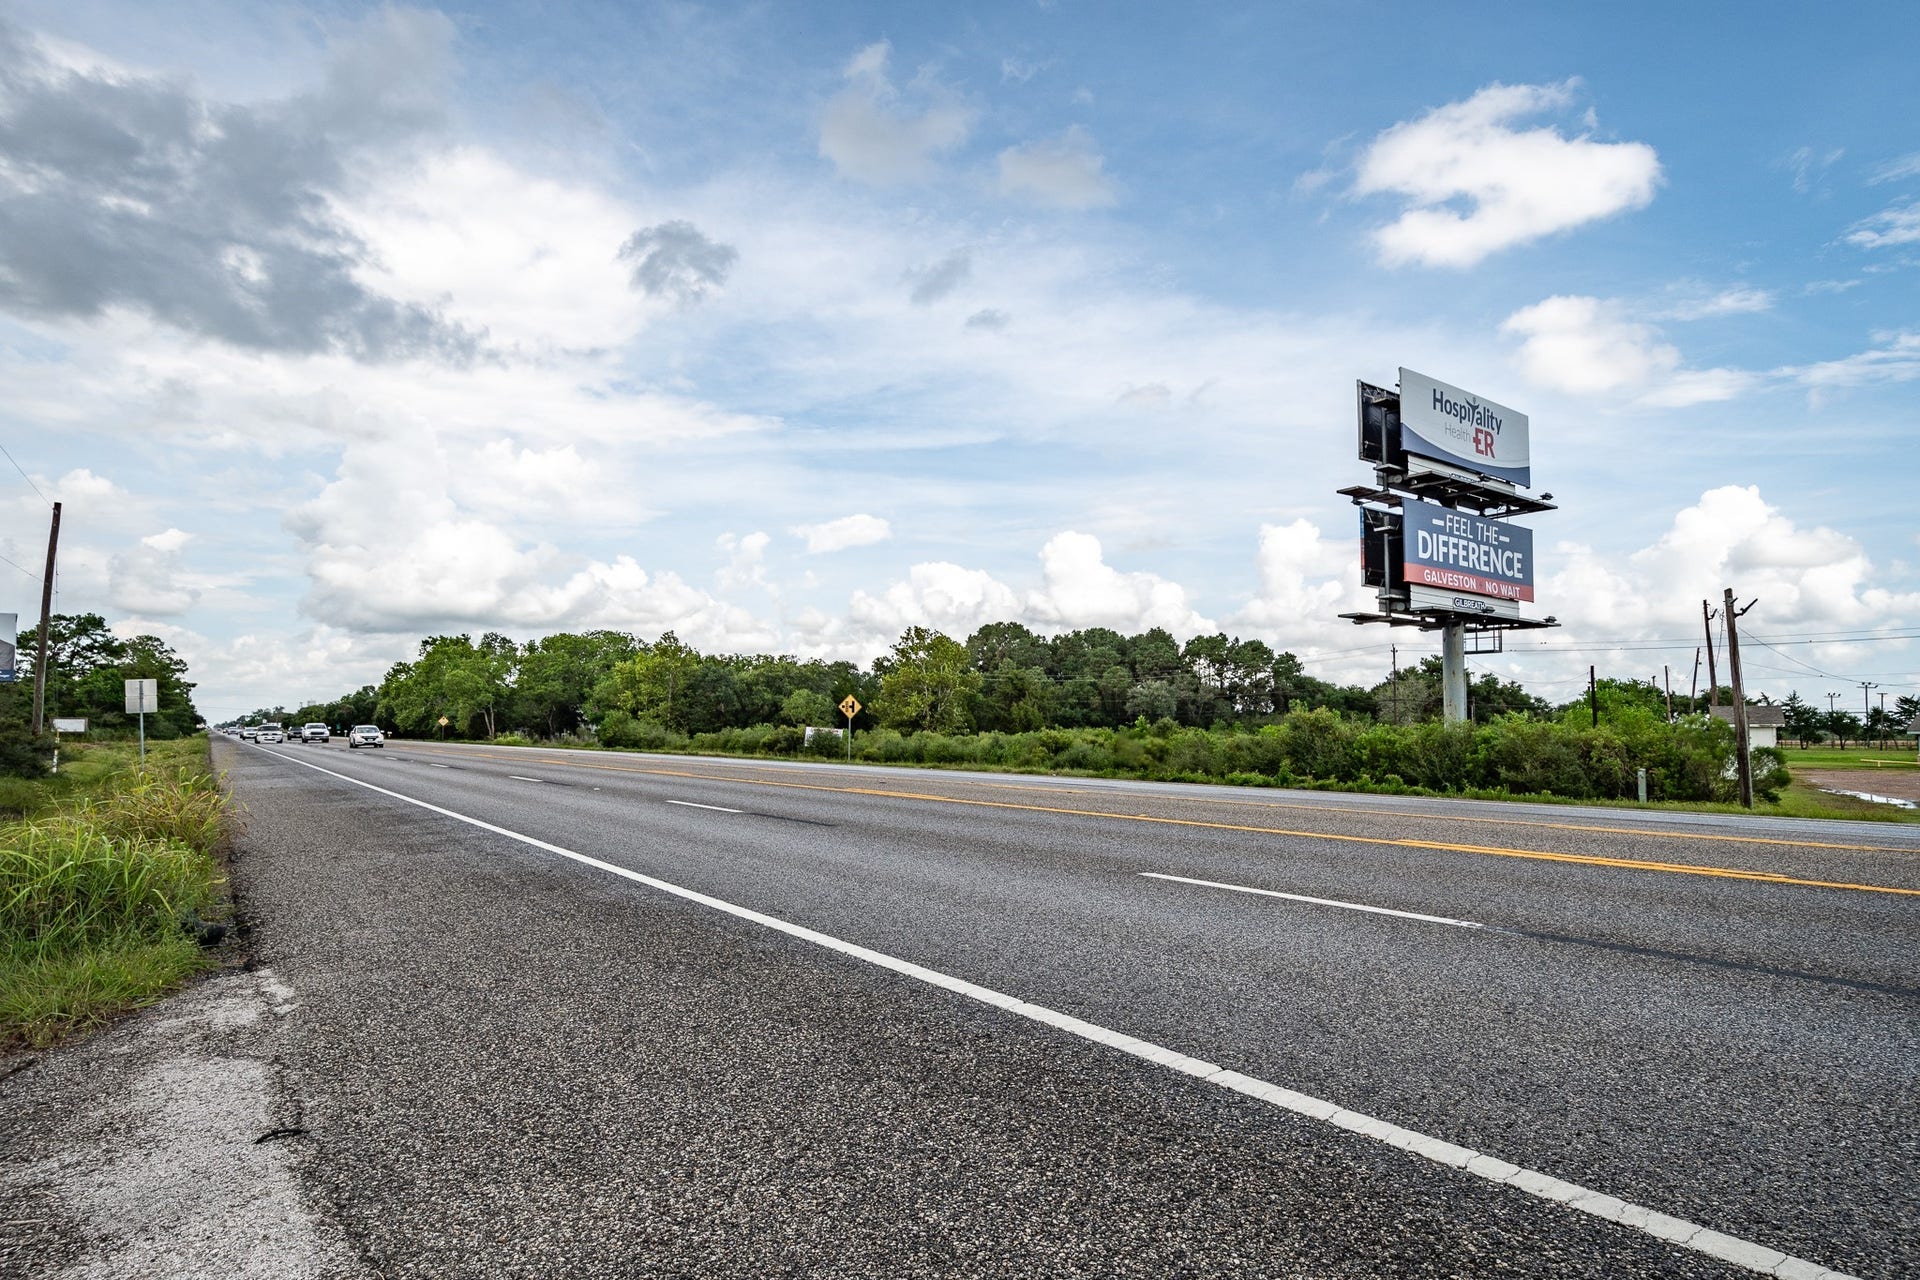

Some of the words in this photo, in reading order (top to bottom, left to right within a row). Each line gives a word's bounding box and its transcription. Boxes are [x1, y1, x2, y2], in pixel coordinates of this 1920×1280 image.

[1444, 421, 1471, 443] Health
[1472, 427, 1495, 459] ER
[1446, 514, 1474, 539] FEEL
[1476, 522, 1498, 545] THE
[1417, 529, 1523, 579] DIFFERENCE
[1423, 569, 1477, 590] GALVESTON
[1485, 581, 1498, 594] NO
[1500, 583, 1521, 598] WAIT
